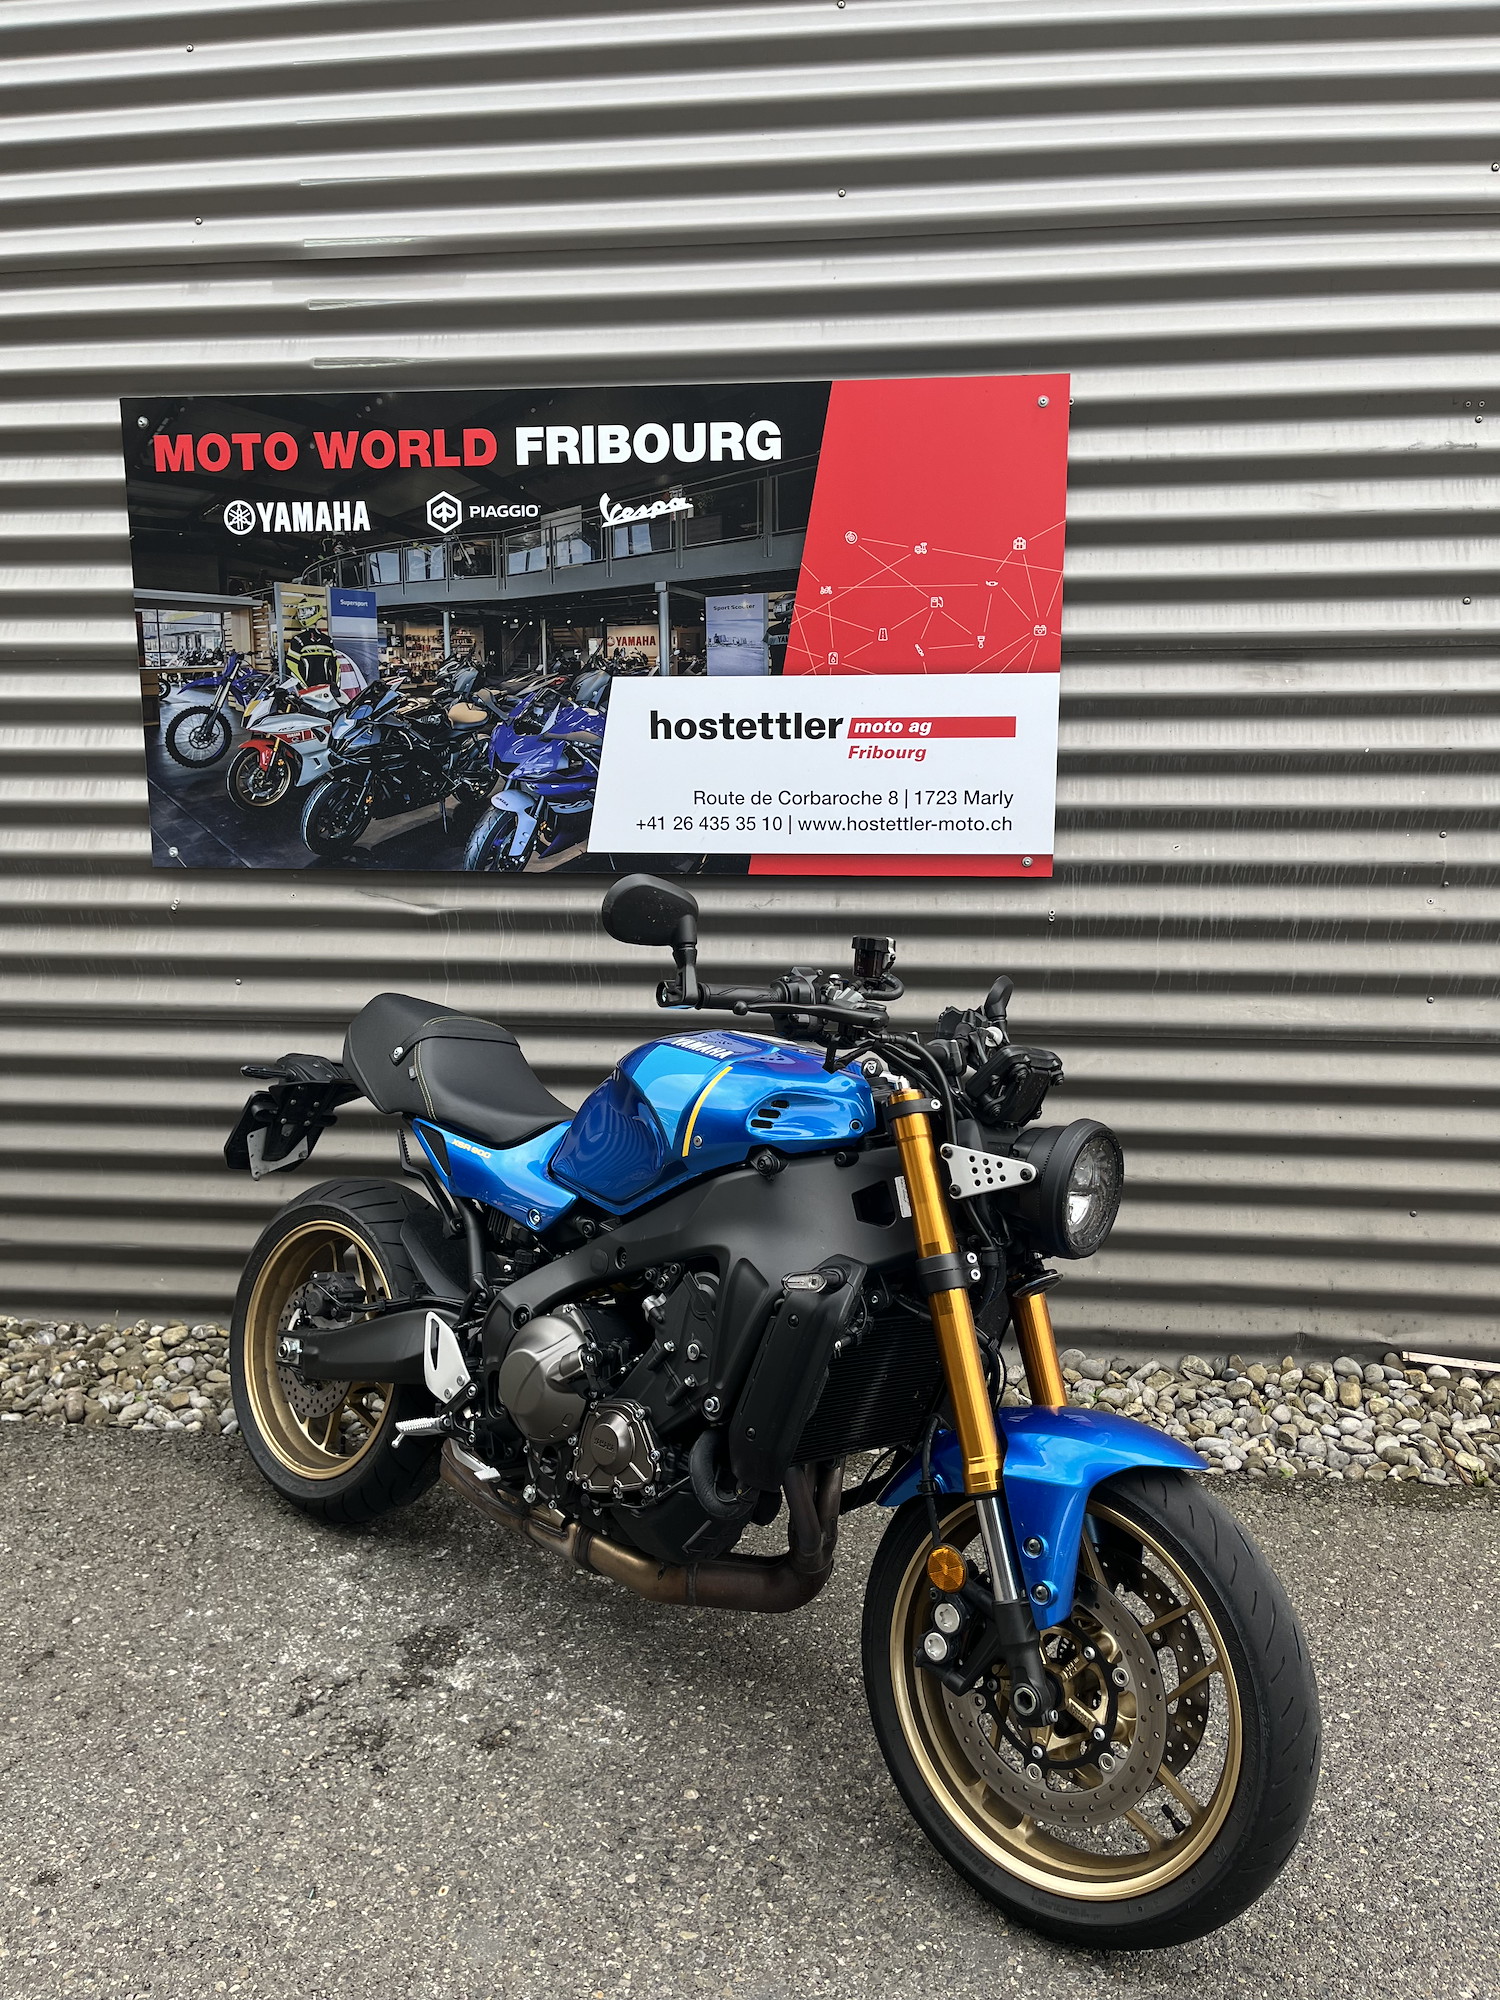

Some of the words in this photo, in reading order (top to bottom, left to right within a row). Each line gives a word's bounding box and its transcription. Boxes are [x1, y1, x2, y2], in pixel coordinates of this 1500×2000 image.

[153, 431, 299, 473] MOTO
[313, 427, 498, 470] WORLD
[515, 420, 782, 466] FRIBOURG
[256, 500, 371, 533] YAMAHA
[469, 504, 539, 518] PIAGGIO
[599, 492, 694, 528] Vespa
[339, 598, 369, 608] Supersport
[616, 635, 656, 647] YAMAHA
[650, 710, 844, 741] hostettler
[853, 719, 904, 734] moto
[908, 721, 933, 736] ag
[847, 745, 927, 762] Fribourg
[693, 790, 745, 806] Route
[750, 790, 773, 806] de
[778, 790, 883, 806] Corbaroche
[888, 790, 899, 806] 8
[915, 790, 958, 806] 1723
[964, 789, 1014, 809] Marly
[636, 816, 665, 831] +41
[673, 816, 694, 831] 26
[698, 816, 730, 831] 435
[735, 816, 756, 831] 35
[762, 816, 783, 831] 10
[797, 815, 1013, 832] www.hostettler-moto.ch
[670, 1037, 735, 1060] YAMAHA
[471, 1146, 492, 1159] 900
